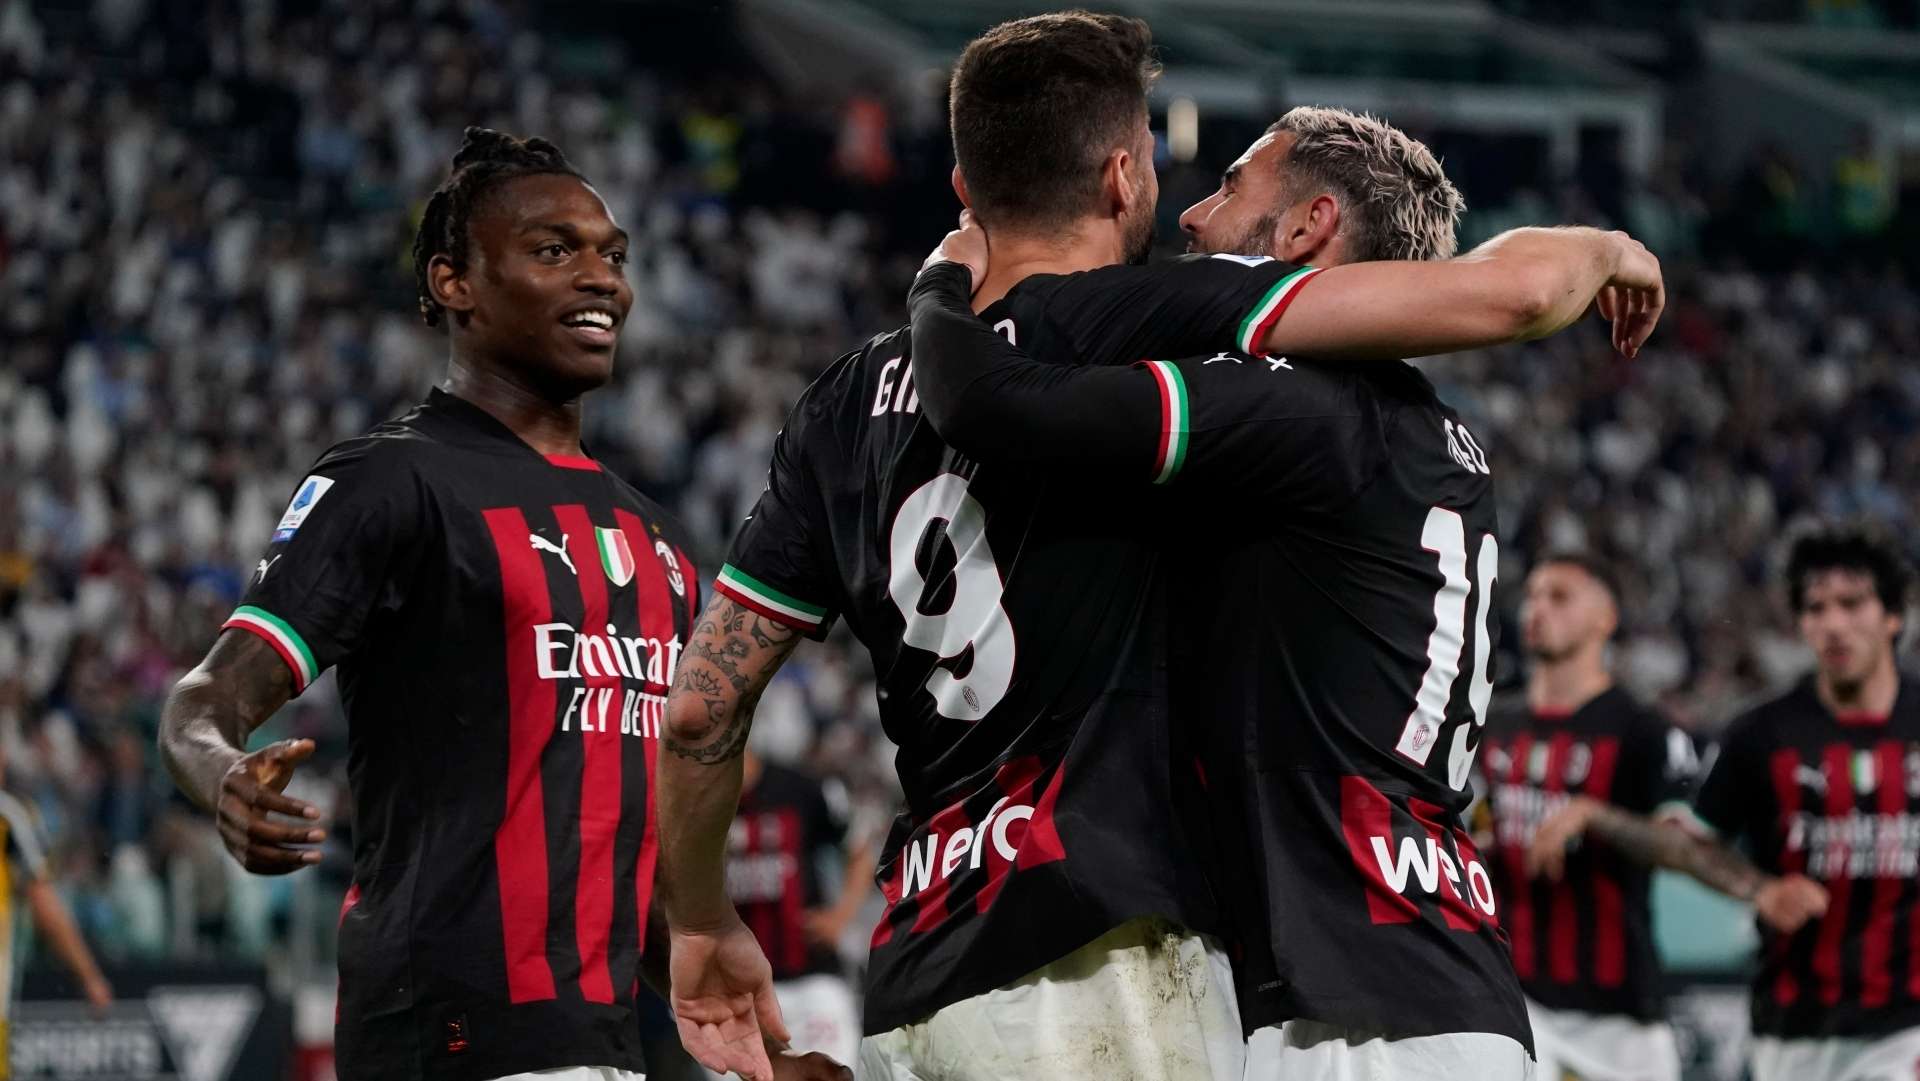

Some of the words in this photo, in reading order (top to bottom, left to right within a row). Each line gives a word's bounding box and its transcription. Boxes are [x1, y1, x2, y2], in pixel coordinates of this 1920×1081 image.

[533, 622, 683, 687] Emirat
[889, 473, 1016, 721] 9
[1396, 506, 1498, 791] 19
[562, 687, 614, 732] FLY
[620, 688, 668, 739] BETT
